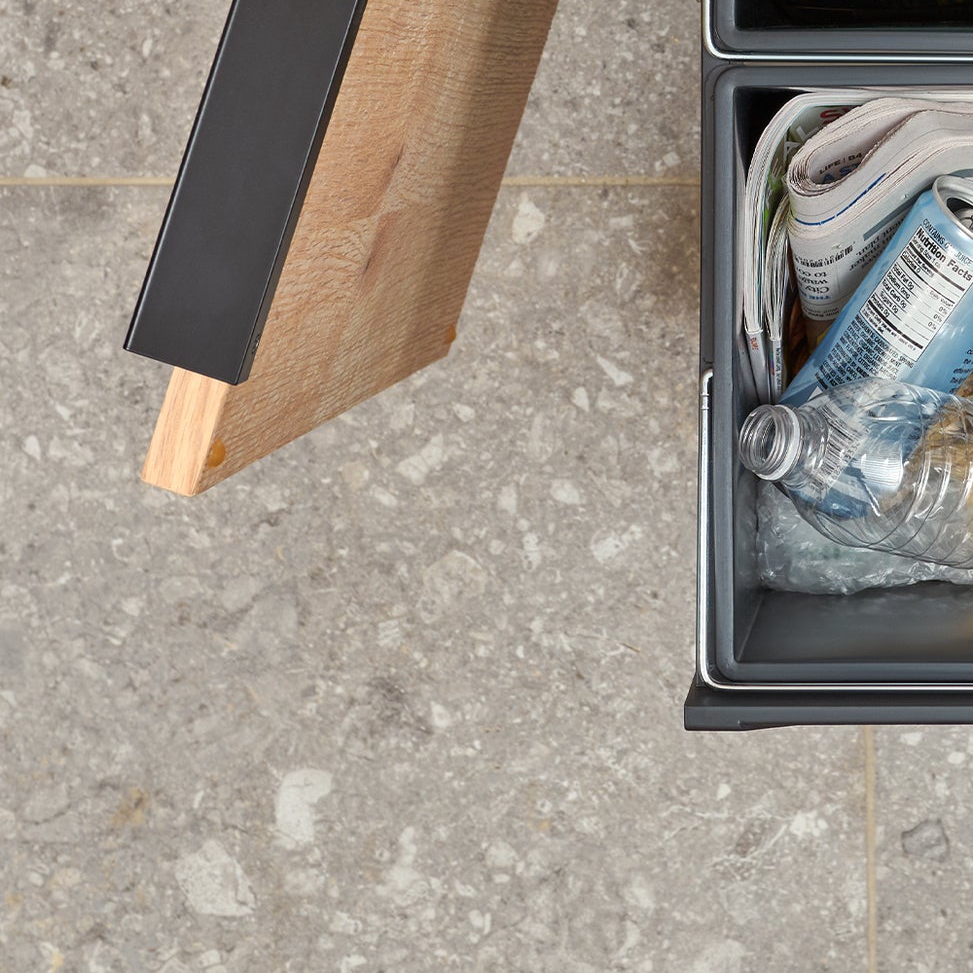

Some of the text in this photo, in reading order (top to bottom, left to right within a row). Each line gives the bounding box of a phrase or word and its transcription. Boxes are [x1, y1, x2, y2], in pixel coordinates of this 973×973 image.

[820, 159, 841, 175] LIFE
[922, 218, 946, 245] CONTAINS
[916, 229, 947, 262] Nutrition
[947, 259, 973, 282] Facts
[805, 285, 830, 294] City
